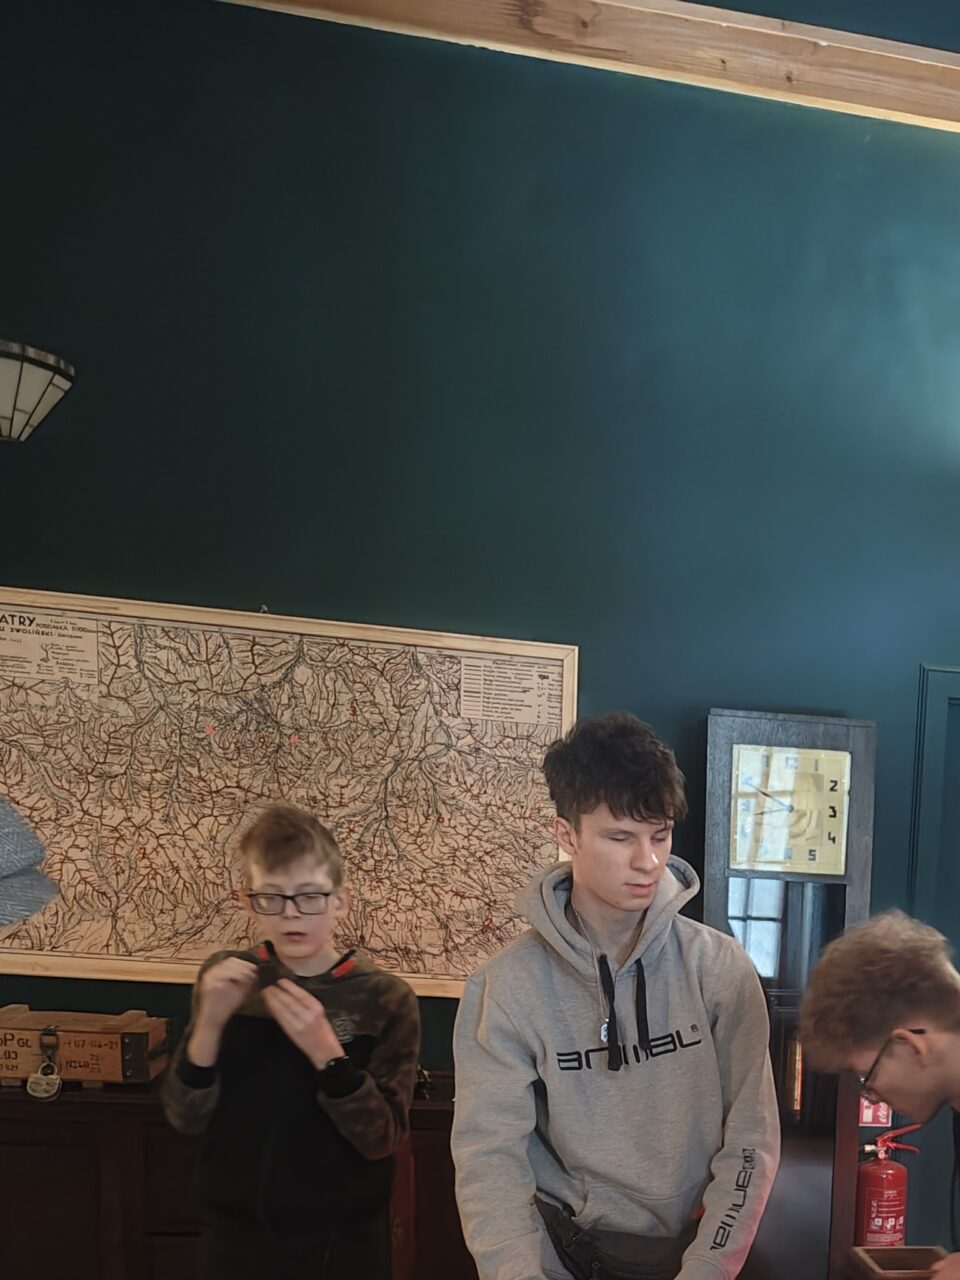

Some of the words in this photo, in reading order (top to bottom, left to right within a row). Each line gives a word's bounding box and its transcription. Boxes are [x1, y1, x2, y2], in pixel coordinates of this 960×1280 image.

[829, 780, 838, 792] 2
[828, 806, 837, 818] 3
[828, 832, 836, 844] 4
[808, 849, 817, 861] 5
